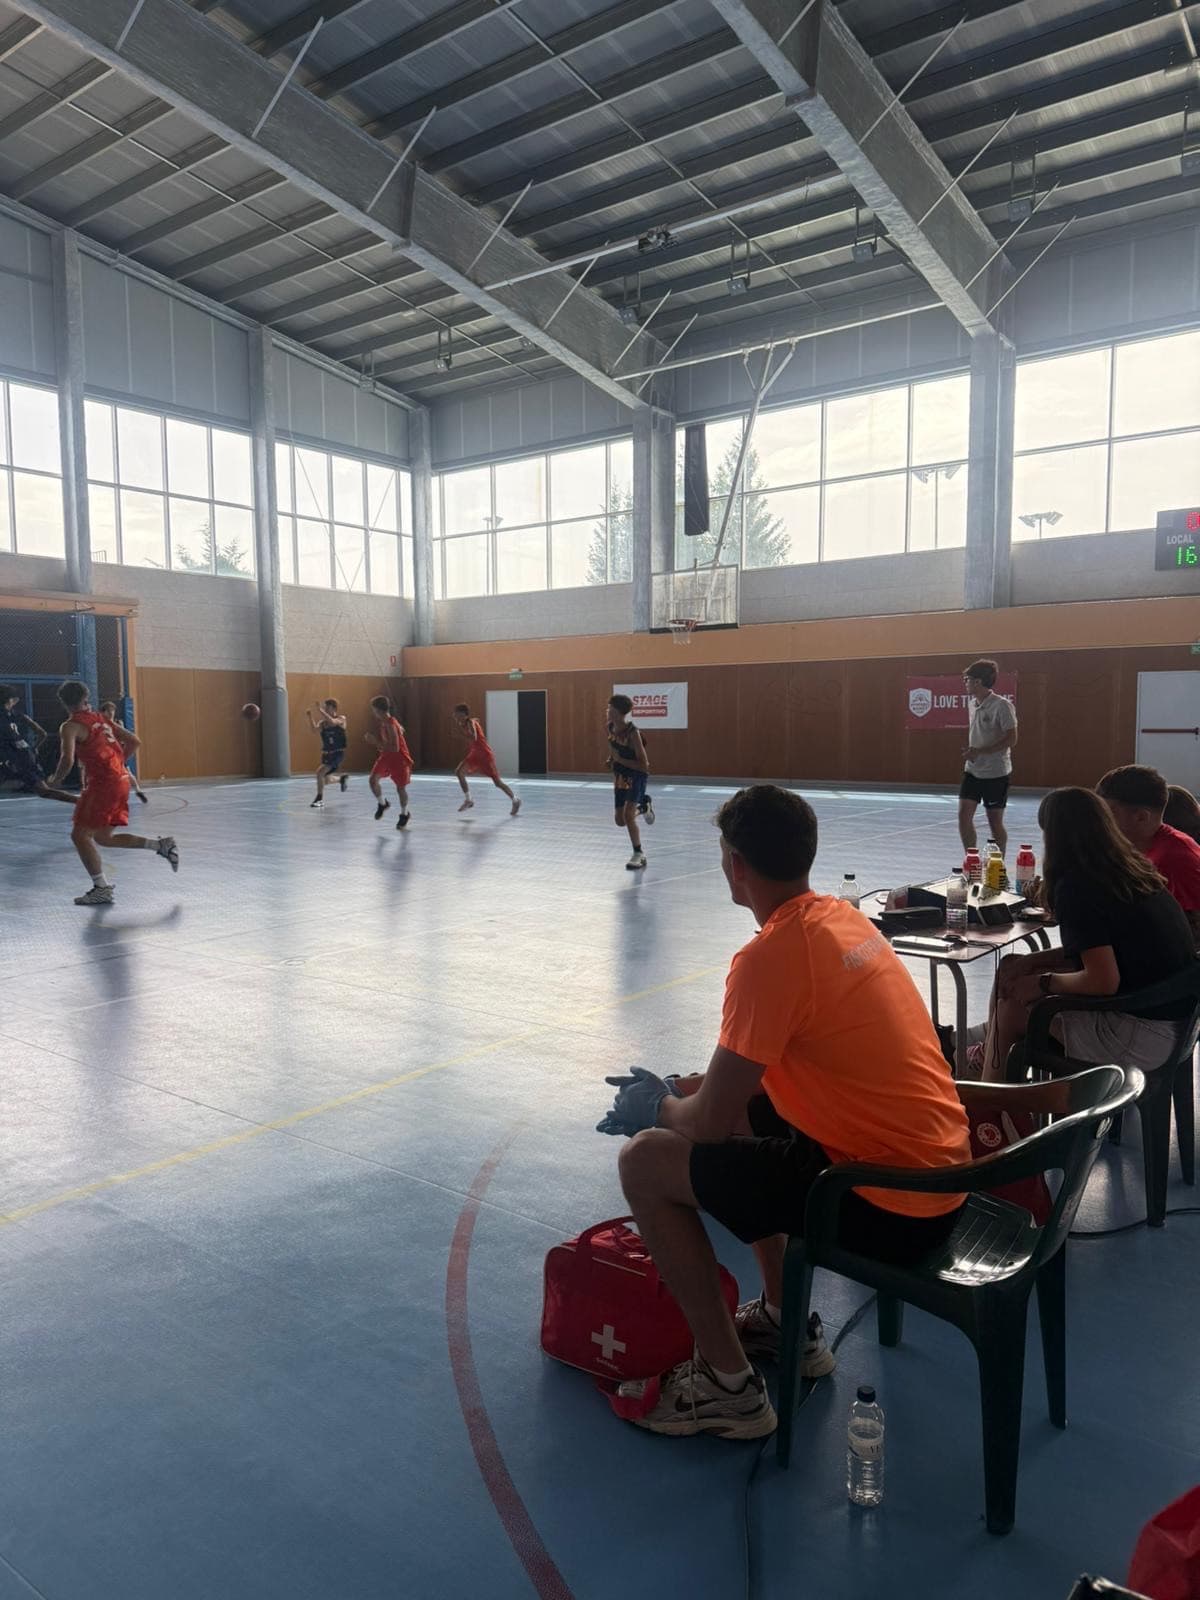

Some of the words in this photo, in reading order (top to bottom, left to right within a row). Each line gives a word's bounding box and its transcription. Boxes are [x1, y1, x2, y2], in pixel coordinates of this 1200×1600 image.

[1166, 534, 1194, 545] LOCAL
[1178, 546, 1198, 565] 16
[632, 695, 668, 706] STAGE
[934, 695, 959, 708] LOVE
